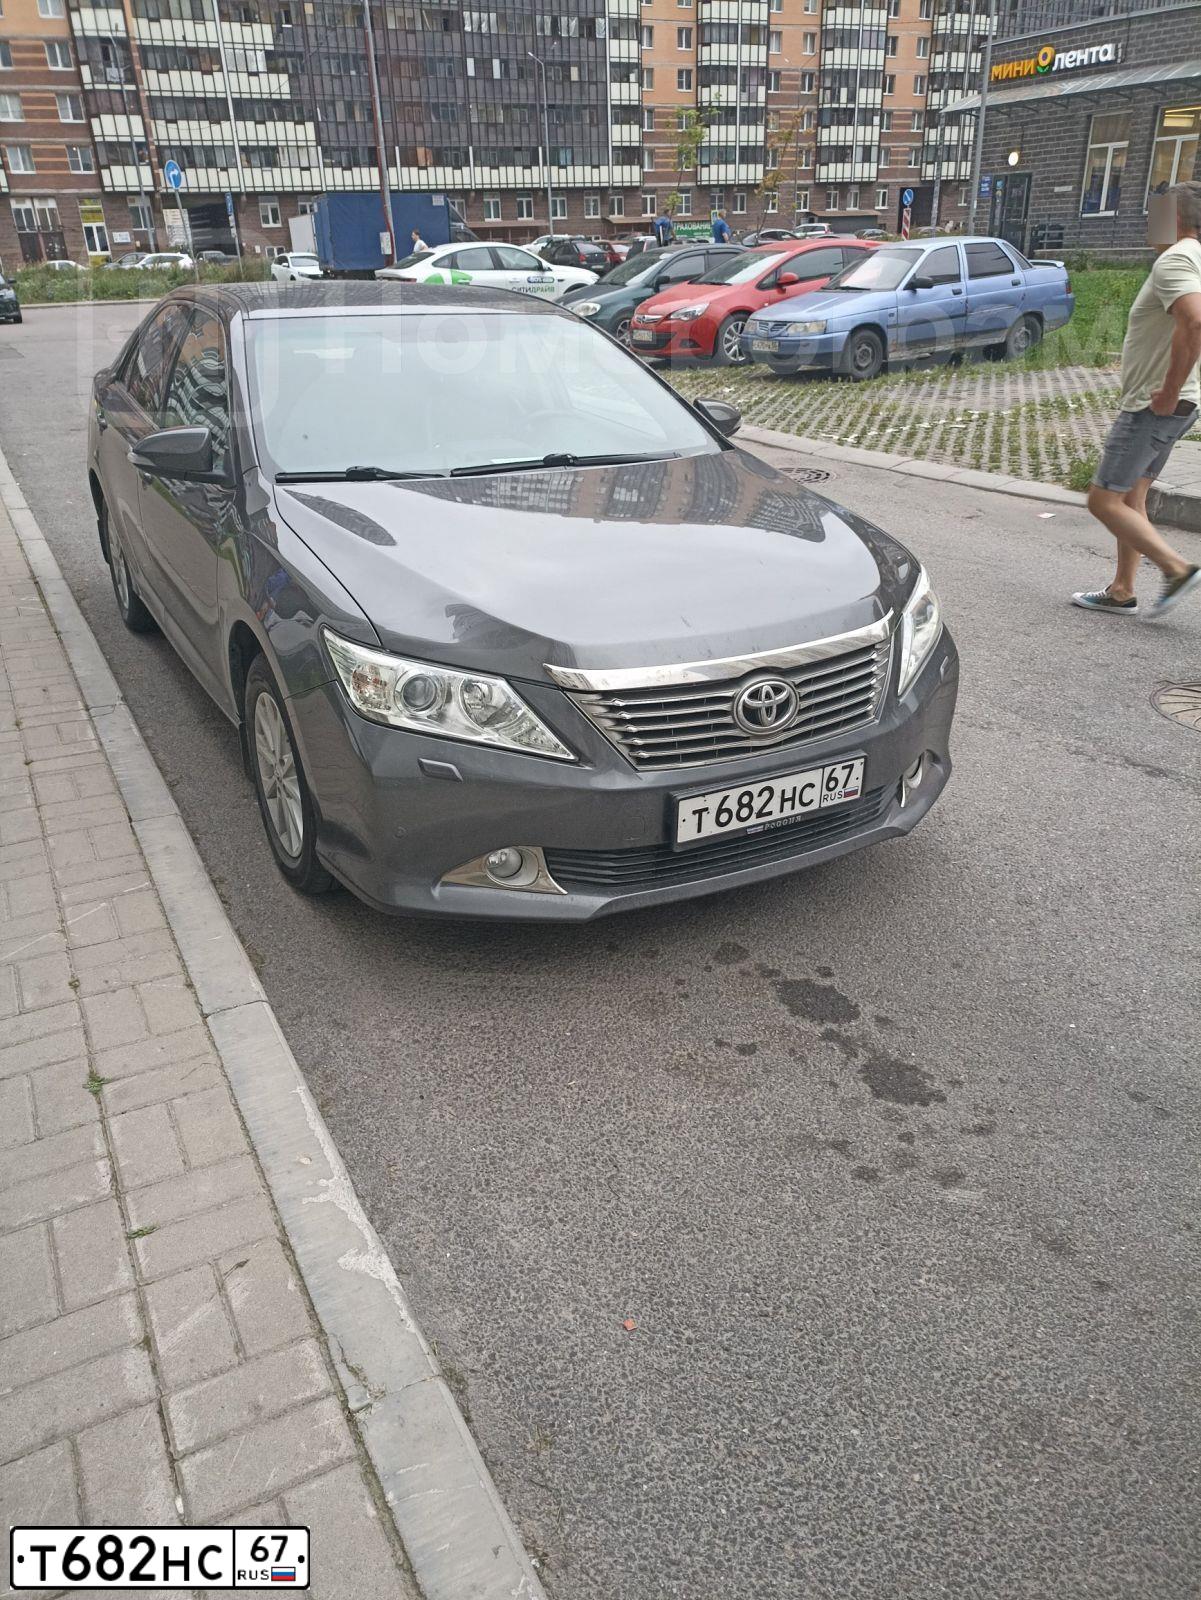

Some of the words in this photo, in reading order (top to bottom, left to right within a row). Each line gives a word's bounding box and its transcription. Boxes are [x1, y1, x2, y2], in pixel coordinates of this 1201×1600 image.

[692, 783, 816, 833] Т682НС
[825, 763, 855, 792] 67
[823, 791, 844, 803] RUS
